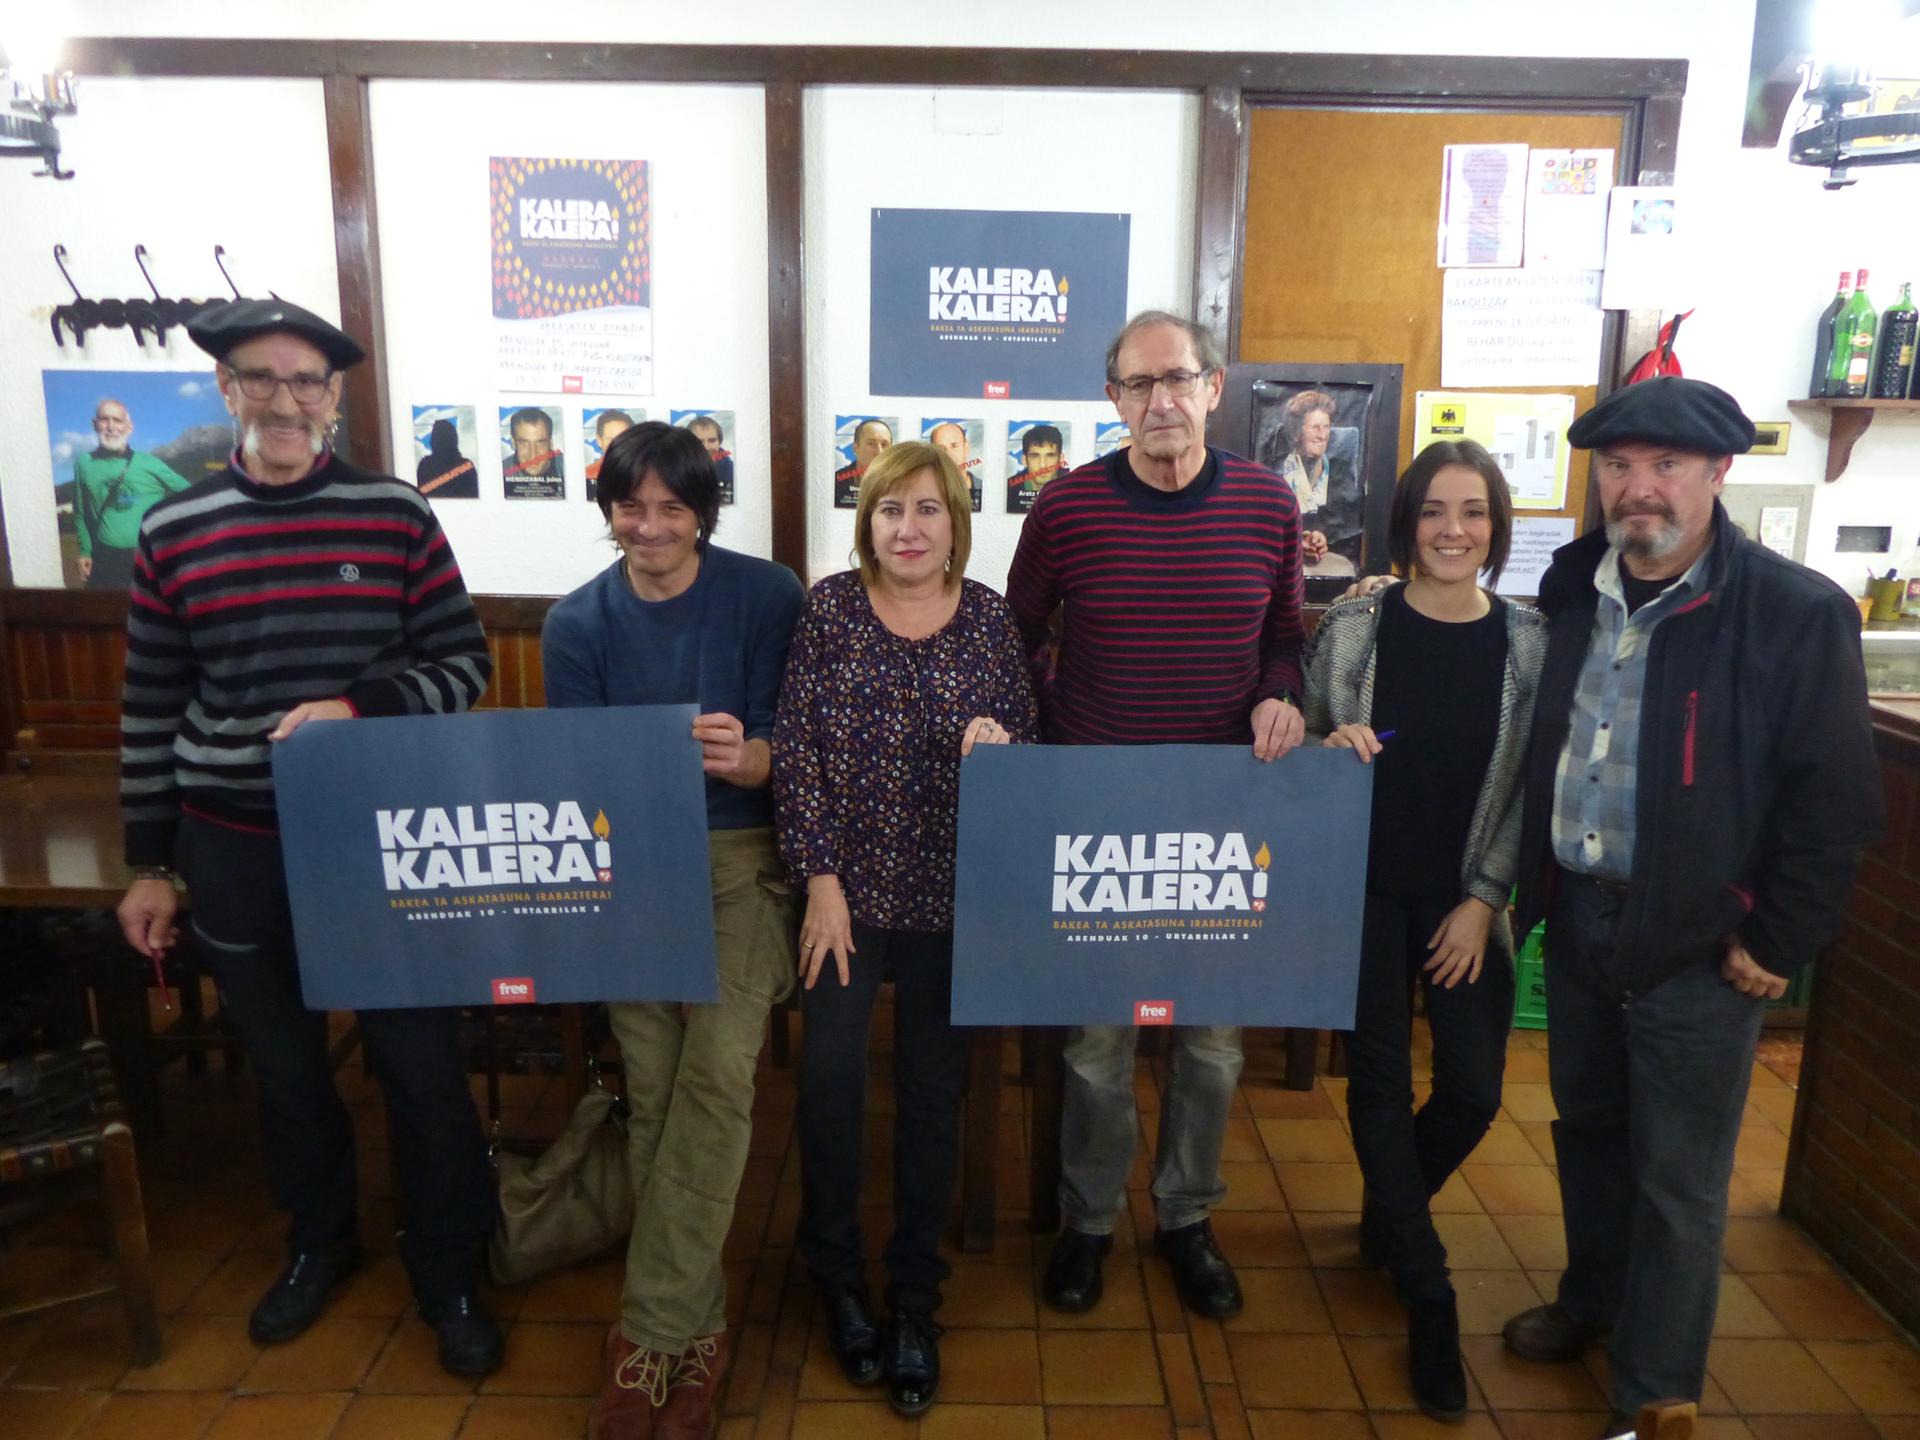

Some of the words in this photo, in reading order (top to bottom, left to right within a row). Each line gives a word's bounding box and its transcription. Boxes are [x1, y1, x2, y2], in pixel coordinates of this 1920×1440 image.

[520, 198, 612, 220] KALERA
[929, 266, 1058, 296] KALERA
[929, 293, 1068, 323] KALERA!
[987, 384, 1006, 394] free
[376, 801, 594, 850] KALERA
[1053, 832, 1254, 873] KALERA
[381, 840, 613, 891] KALERA!
[390, 898, 429, 909] BAKEA
[435, 897, 449, 907] TA
[453, 892, 531, 906] ASKATASUNA
[536, 889, 612, 902] IRABAZTERA!
[1051, 870, 1269, 913] KALERA!
[407, 910, 472, 921] ABENDUAK
[480, 908, 494, 917] 10
[514, 905, 587, 915] URTARRILAK
[593, 905, 601, 913] 8
[1053, 920, 1090, 930] BAKEA
[1095, 920, 1108, 929] TA
[1113, 918, 1185, 930] ASKATASUNA
[1190, 918, 1263, 929] IRABAZTERA!
[1067, 934, 1129, 942] ABENDUAK
[1166, 933, 1237, 941] URTARRILAK
[499, 982, 528, 995] free
[1140, 1004, 1167, 1017] free
